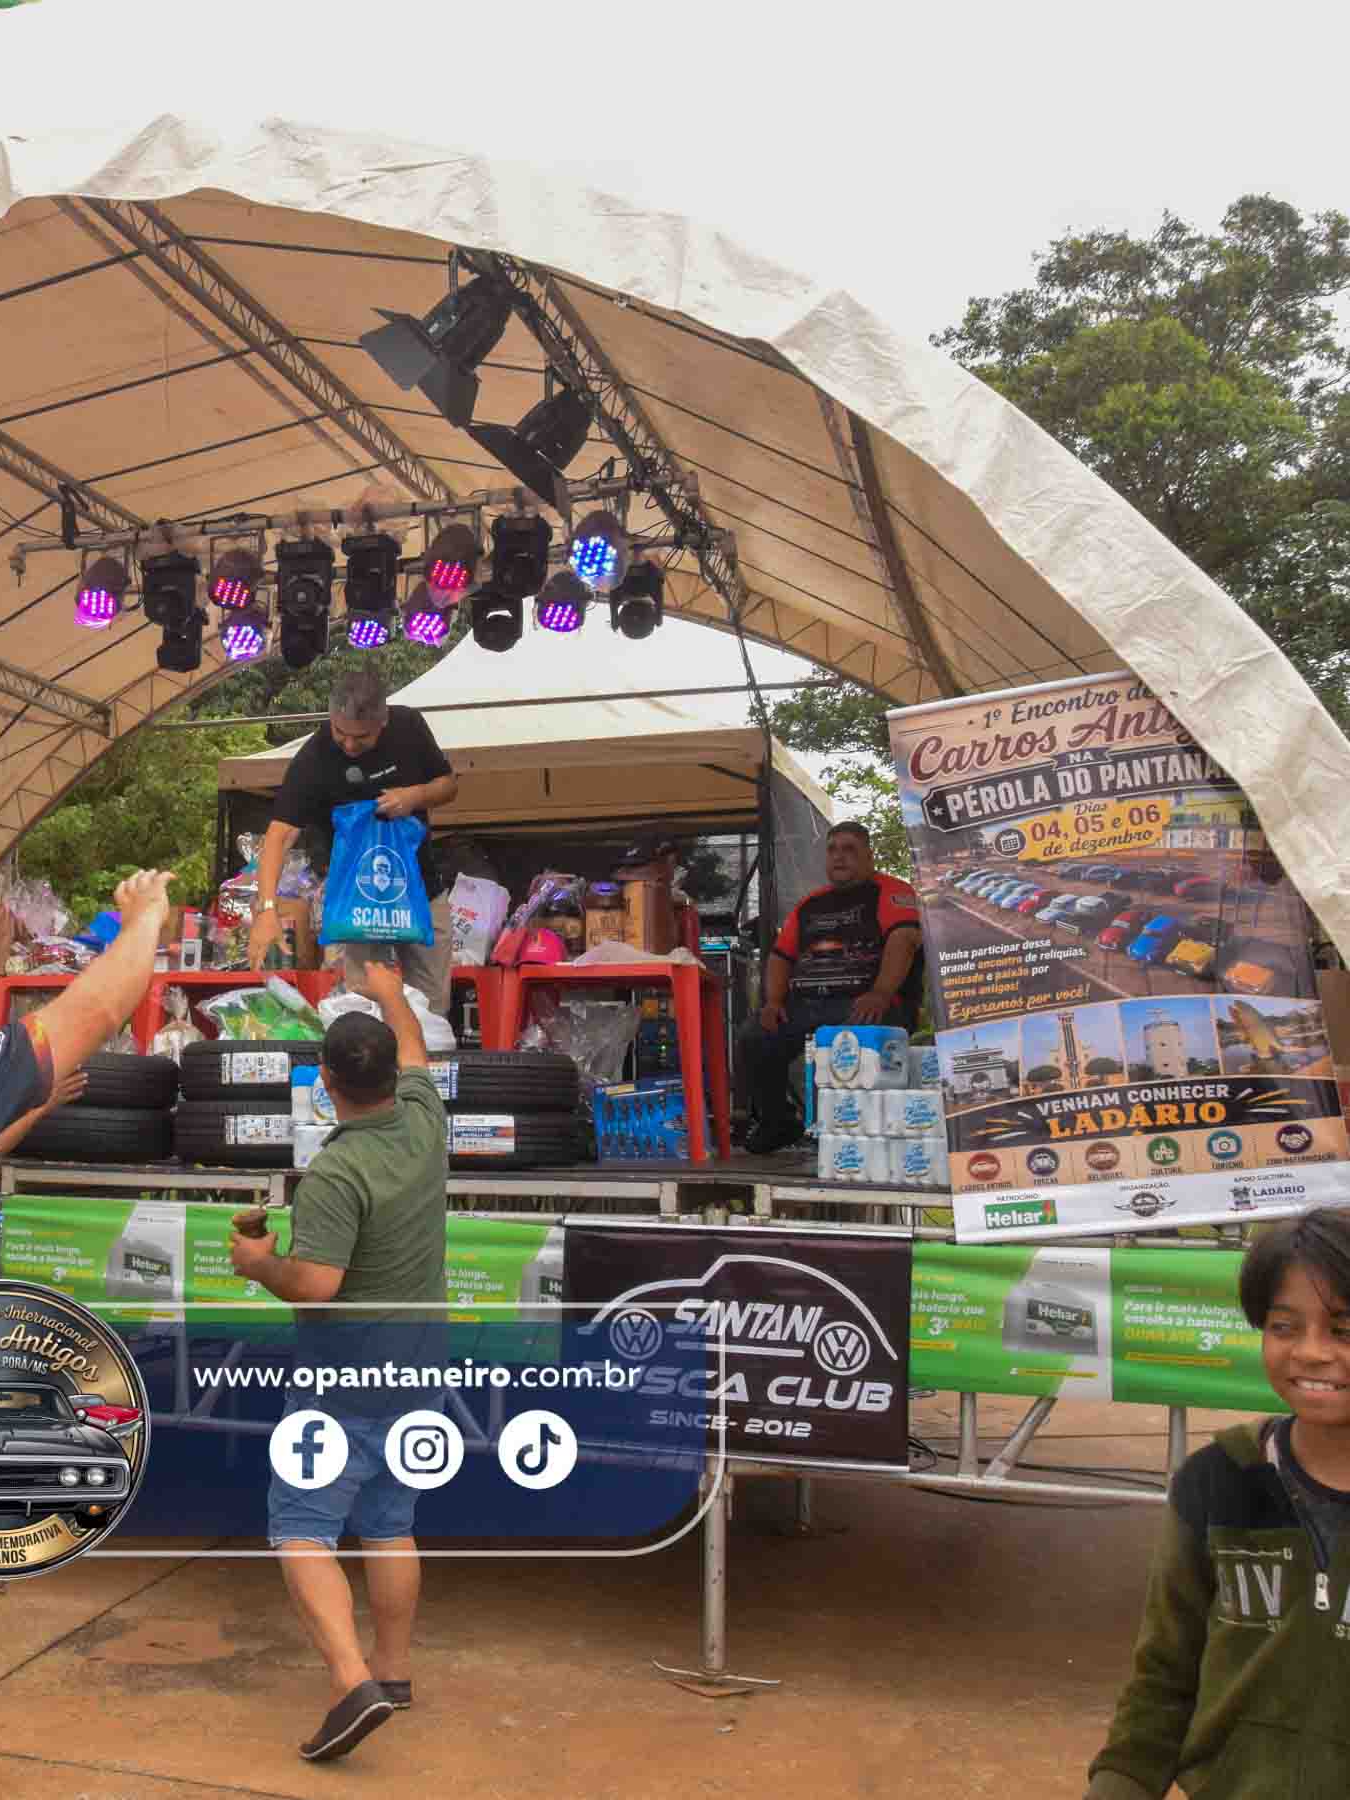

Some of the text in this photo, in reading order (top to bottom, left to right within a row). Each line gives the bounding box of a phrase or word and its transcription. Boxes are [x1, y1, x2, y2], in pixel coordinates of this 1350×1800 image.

[1011, 687, 1120, 725] Encontro
[909, 722, 1058, 783] Carros
[1068, 752, 1094, 765] NA
[946, 771, 1052, 822] PÉROLA
[1058, 764, 1092, 797] DO
[1074, 801, 1108, 816] Dias
[1031, 805, 1161, 842] 04, 05 e 06
[1042, 828, 1153, 857] de dezembro
[352, 907, 411, 928] SCALON
[938, 949, 969, 961] Venha
[971, 942, 1020, 959] participar
[940, 961, 976, 976] grande
[1025, 951, 1038, 963] de
[986, 973, 993, 981] e
[1032, 965, 1049, 976] por
[949, 998, 1023, 1020] Esperamos
[1026, 993, 1051, 1009] por
[1036, 1083, 1230, 1117] VENHAM CONHECER
[986, 1208, 1043, 1231] Heliar
[1037, 1303, 1080, 1322] Heliar
[766, 1375, 893, 1412] CLUB
[744, 1418, 812, 1438] 2012
